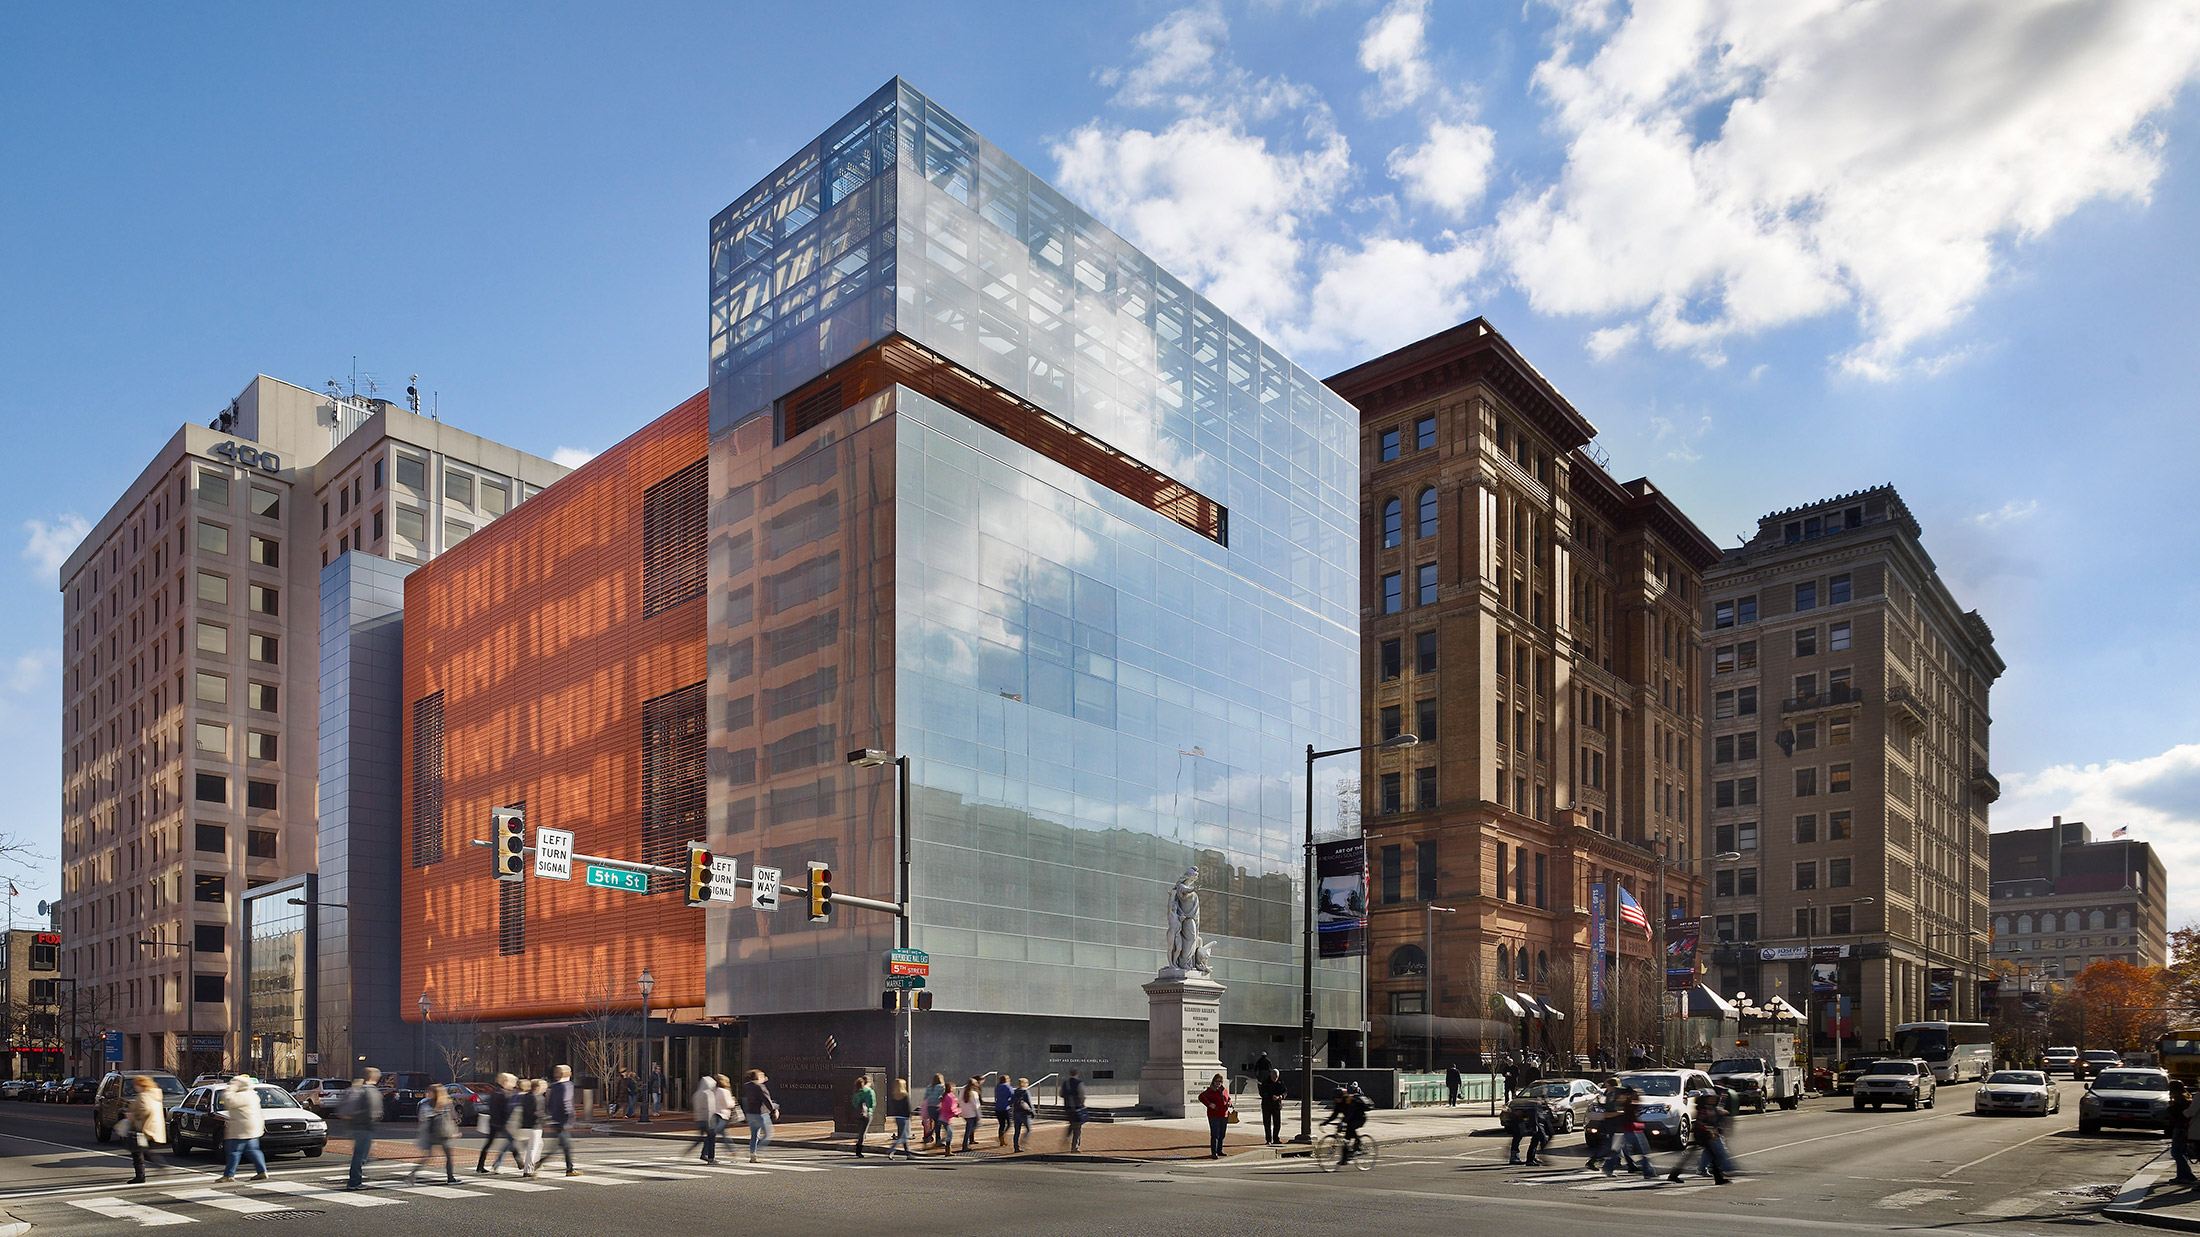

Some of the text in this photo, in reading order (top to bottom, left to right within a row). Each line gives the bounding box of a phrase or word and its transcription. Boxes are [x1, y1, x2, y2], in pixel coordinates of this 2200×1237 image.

[217, 440, 280, 473] 400
[543, 834, 567, 846] LEFT
[542, 848, 566, 860] TURN
[539, 861, 567, 874] SIGNAL
[712, 863, 731, 872] LEFT
[595, 870, 639, 887] 5th St
[712, 874, 731, 884] TURN
[758, 869, 775, 882] ONE
[710, 885, 732, 897] SIGNAL
[758, 882, 775, 893] WAY
